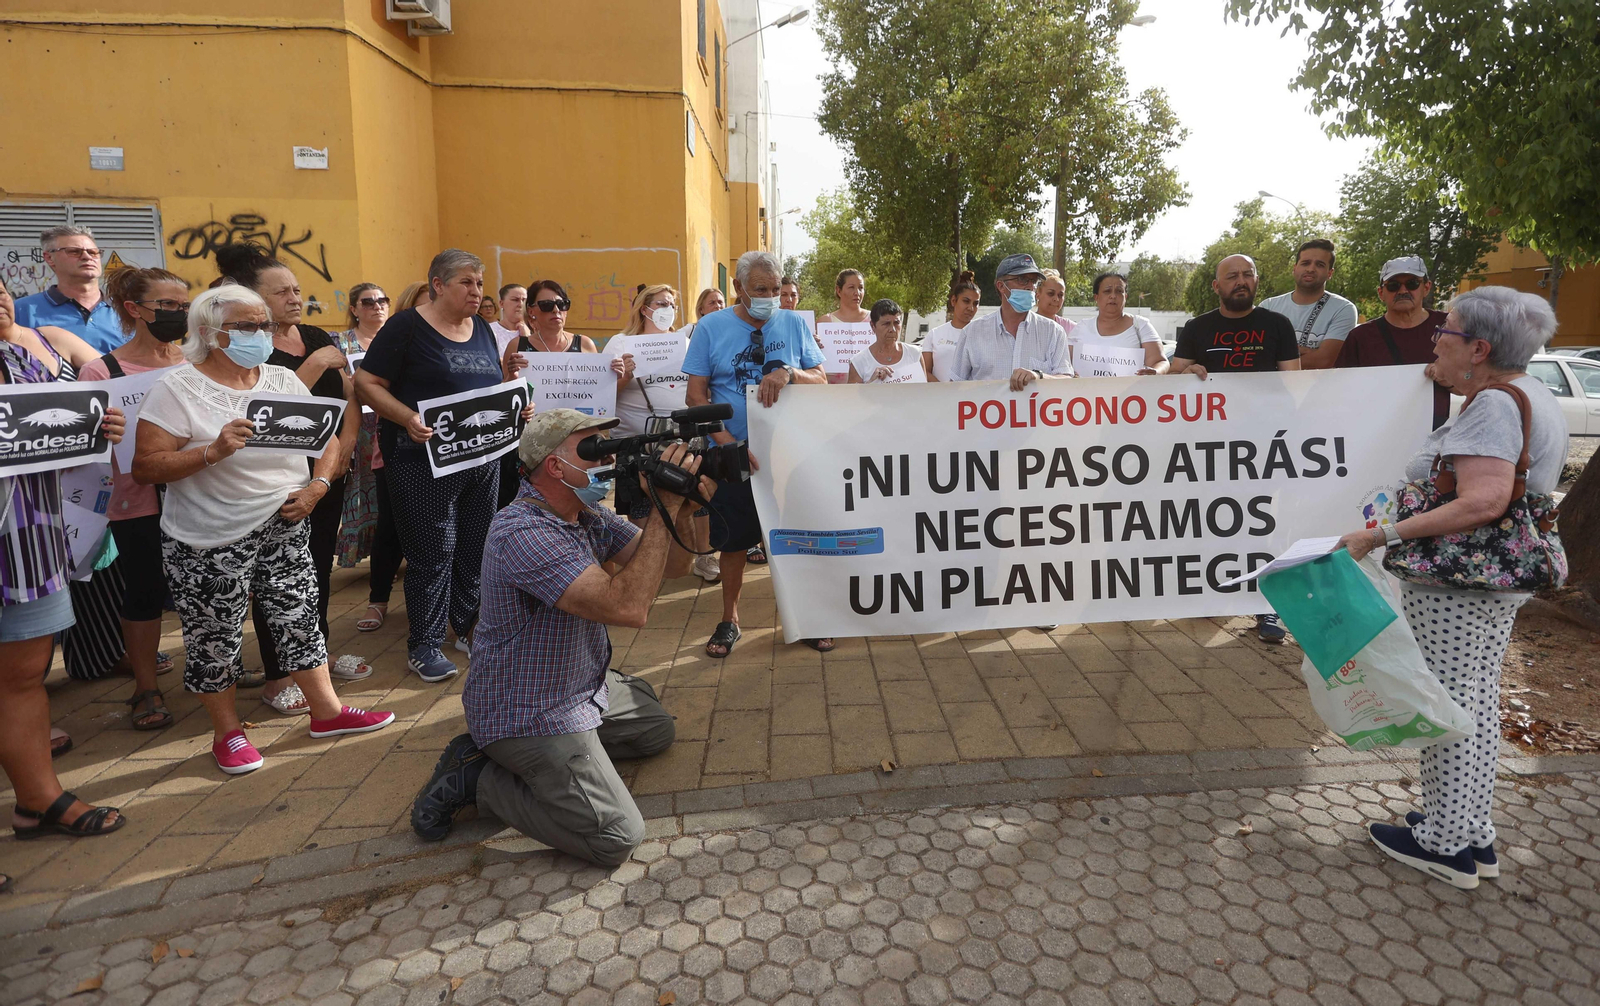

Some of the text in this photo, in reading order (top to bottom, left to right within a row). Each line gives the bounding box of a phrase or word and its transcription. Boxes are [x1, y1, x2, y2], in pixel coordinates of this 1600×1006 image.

[1213, 330, 1265, 346] ICON
[576, 363, 607, 372] MÍNIMA
[1079, 353, 1137, 366] RENTA MÍNIMA
[1223, 352, 1257, 368] ICE
[555, 378, 598, 386] INSERCIÓN
[645, 374, 689, 385] d'amou
[901, 373, 913, 382] Sur
[121, 392, 145, 407] RE
[545, 391, 594, 400] EXCLUSIÓN
[957, 392, 1227, 430] POLÍGONO SUR
[0, 433, 90, 454] endesa
[437, 426, 514, 455] endesa
[34, 448, 59, 456] NORMALIDAD
[842, 429, 1348, 512] ¡NI UN PASO ATRÁS!
[68, 488, 84, 506] ÓN
[1356, 485, 1384, 511] Asociación
[915, 496, 1276, 554] NECESITAMOS
[849, 570, 924, 616] UN
[941, 560, 1074, 610] PLAN
